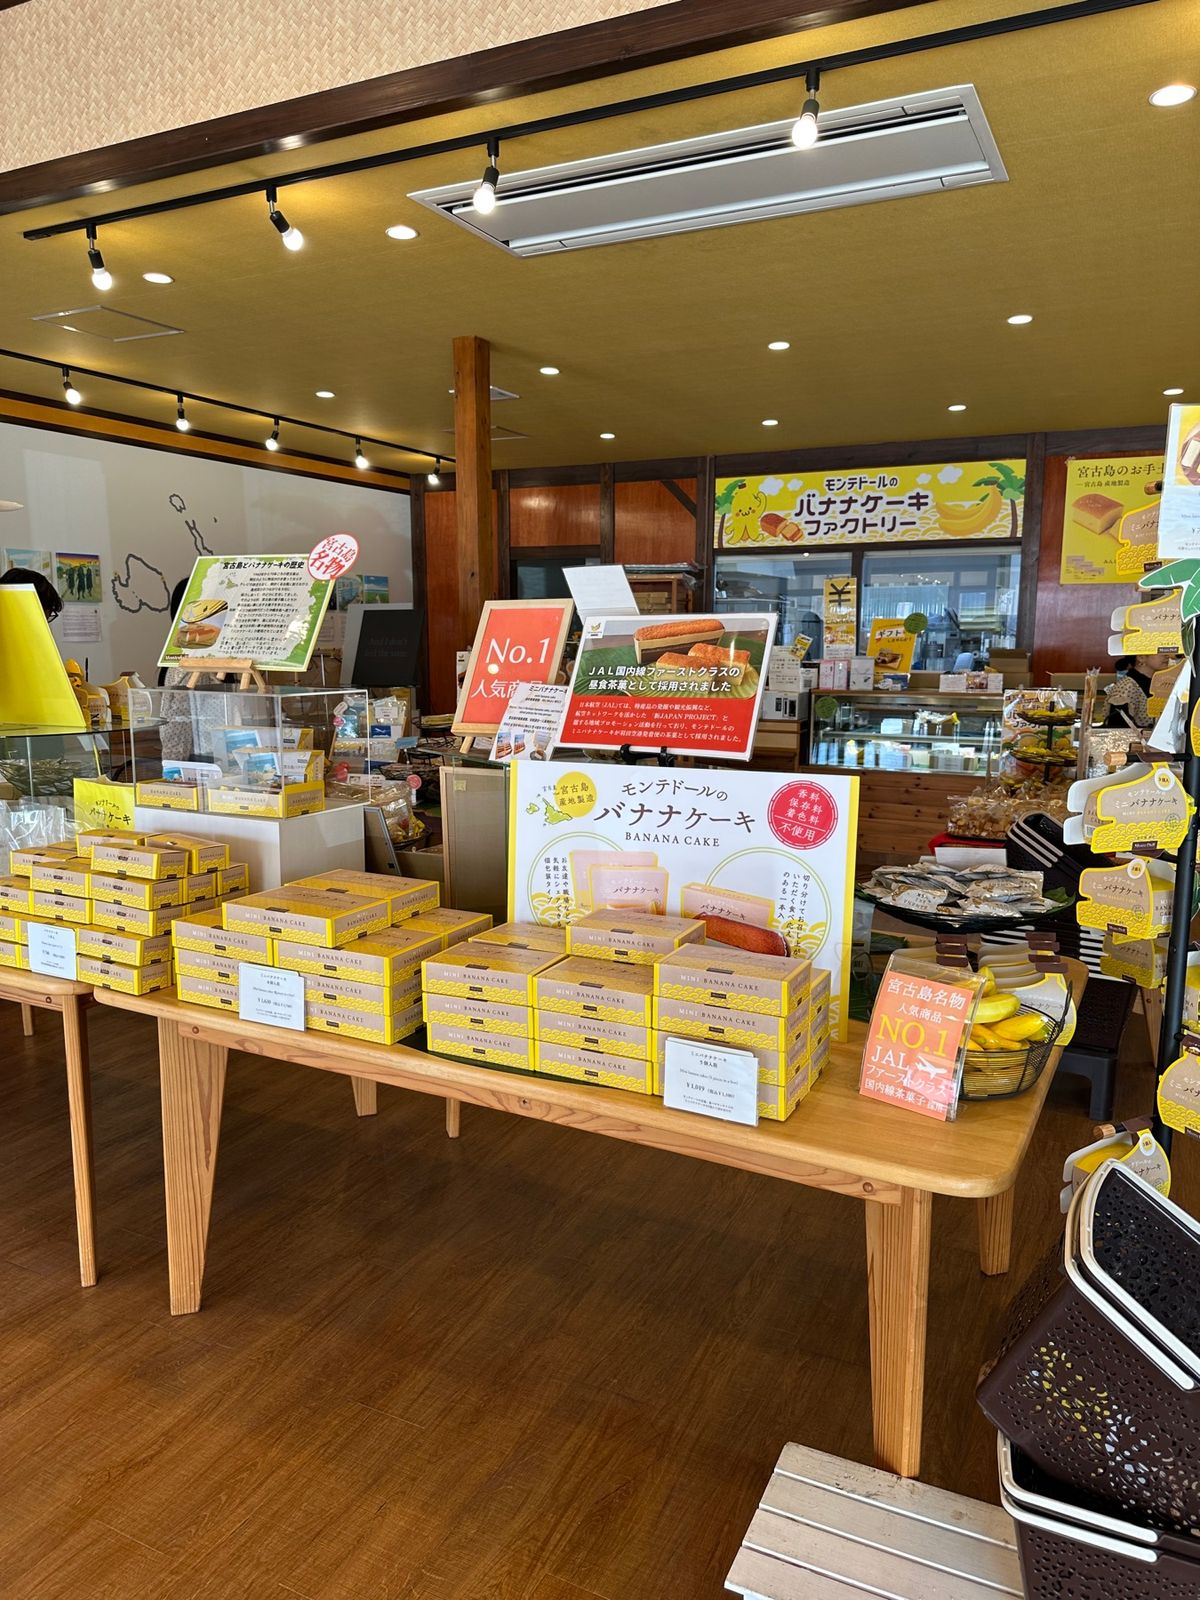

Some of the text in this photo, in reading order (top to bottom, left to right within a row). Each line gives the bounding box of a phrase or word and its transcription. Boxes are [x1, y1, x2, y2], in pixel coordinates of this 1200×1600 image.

[824, 476, 898, 491] モンテドールの
[794, 492, 929, 517] バナナケーキ
[804, 516, 917, 536] ファクトリー
[322, 537, 356, 564] 宮古島
[310, 549, 346, 576] 名物
[486, 638, 550, 664] No.1
[588, 666, 740, 678] JAL国内線ファーストクラスの
[588, 679, 732, 692] 昼食茶菓として採用されました
[560, 782, 590, 794] 宮古島
[621, 778, 728, 802] モンテドールの
[798, 790, 820, 802] 香料
[789, 797, 823, 815] 保存料
[1115, 797, 1178, 809] ミニバナナケーキ
[592, 800, 756, 834] バナナケーキ
[785, 808, 820, 826] 着色料
[624, 832, 720, 848] BANANA CAKE
[778, 822, 816, 842] 不使用
[613, 886, 660, 895] バナナケーキ
[701, 904, 746, 921] バナナケーキ
[786, 872, 800, 938] いただく食べ応え
[263, 914, 288, 926] BANANA
[290, 918, 306, 928] CAKE
[794, 874, 810, 956] 切り分けてお召し上が
[208, 933, 231, 944] BANANA
[232, 936, 248, 946] CAKE
[588, 934, 656, 949] MINI BANANA CAKE
[212, 960, 236, 971] BANANA
[298, 950, 362, 966] MINI BANANA CAKE
[444, 970, 509, 985] MINI BANANA CAKE
[680, 974, 760, 992] MINI BANANA CAKE
[317, 982, 362, 995] BANANA CAKE
[556, 988, 625, 1004] MINI BANANA CAKE
[886, 978, 966, 1010] 宮古島名物
[320, 1010, 364, 1023] BANANA CAKE
[445, 1002, 510, 1017] MINI BANANA CAKE
[679, 1008, 757, 1027] MINI BANANA CAKE
[896, 1004, 943, 1024] 人気商品
[558, 1020, 626, 1037] MINI BANANA CAKE
[875, 1013, 950, 1057] NO.1
[448, 1032, 511, 1048] MINI BANANA CAKE
[558, 1052, 626, 1070] MINI BANANA CAKE
[871, 1046, 910, 1071] JAL
[864, 1078, 926, 1106] 国内線茶菓子
